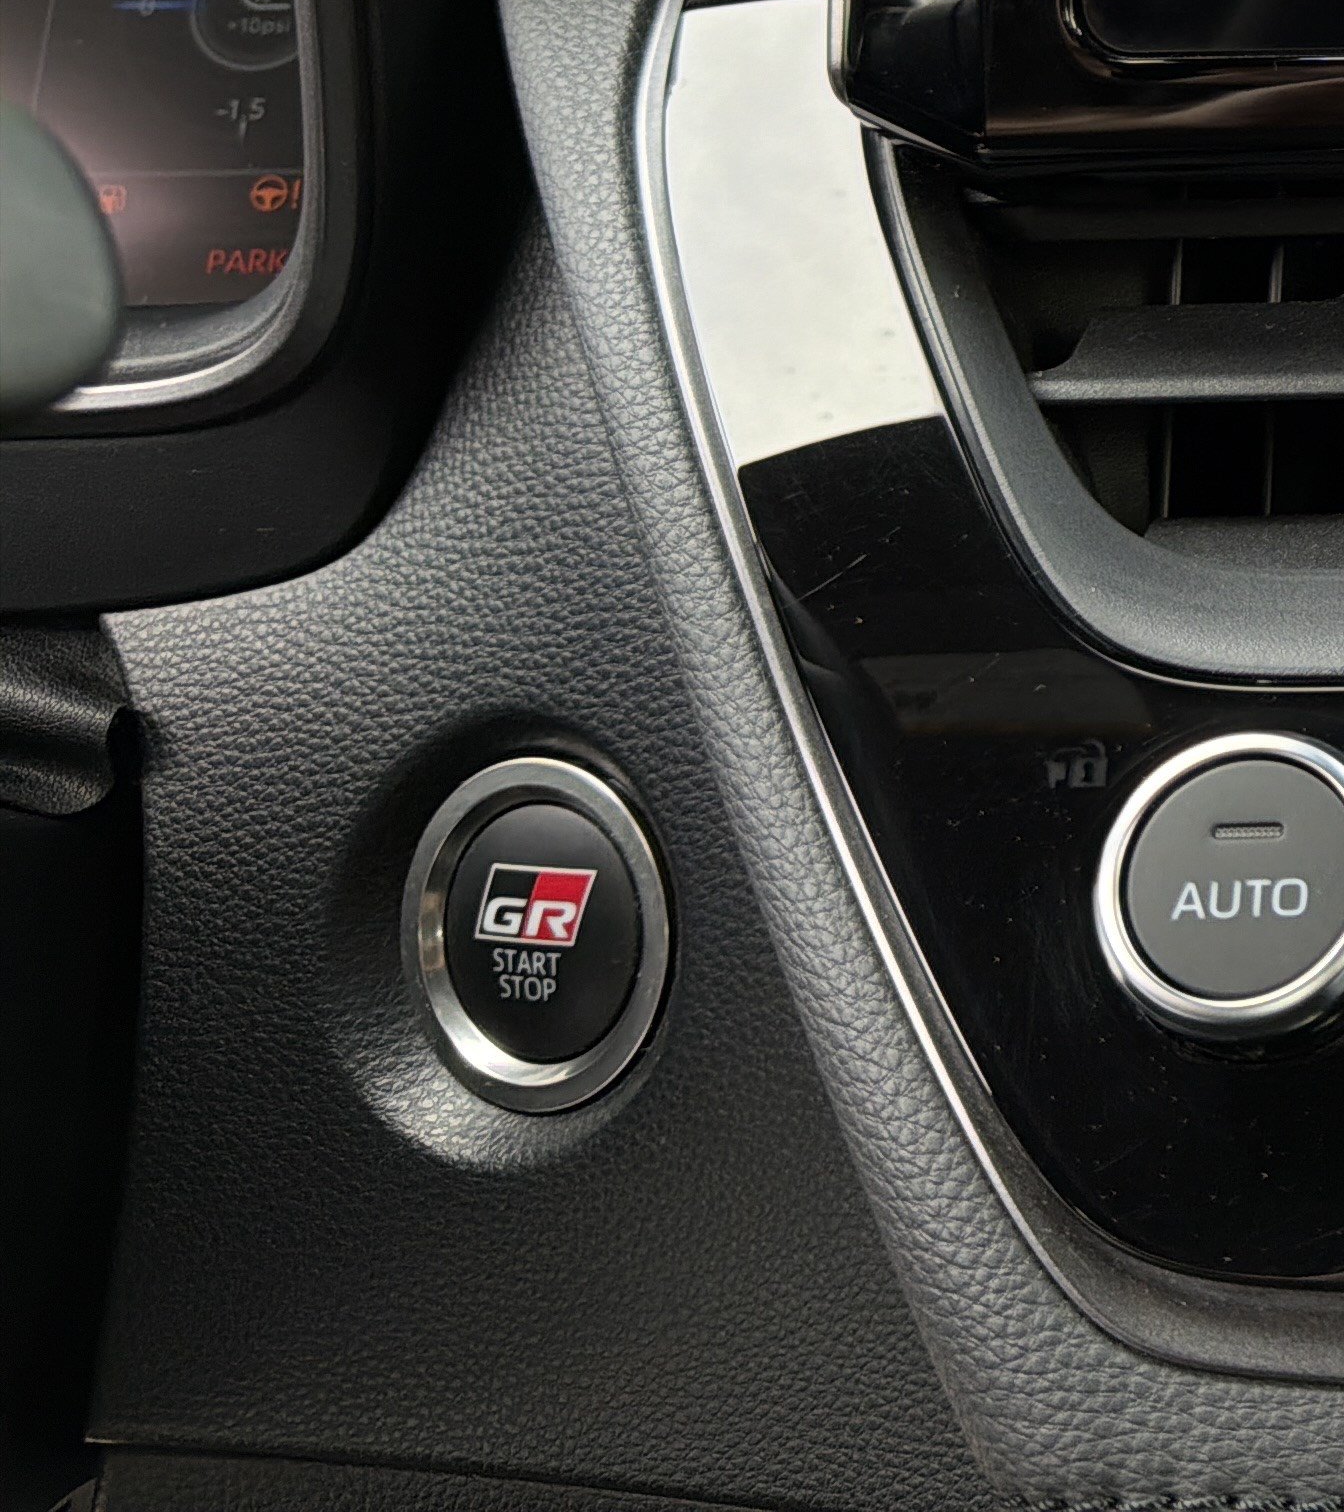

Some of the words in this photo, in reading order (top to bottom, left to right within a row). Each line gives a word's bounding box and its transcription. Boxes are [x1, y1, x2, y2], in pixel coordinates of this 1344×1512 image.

[1171, 878, 1309, 921] AUTO
[484, 898, 577, 938] GR
[493, 949, 561, 976] START
[500, 975, 557, 1001] STOP
